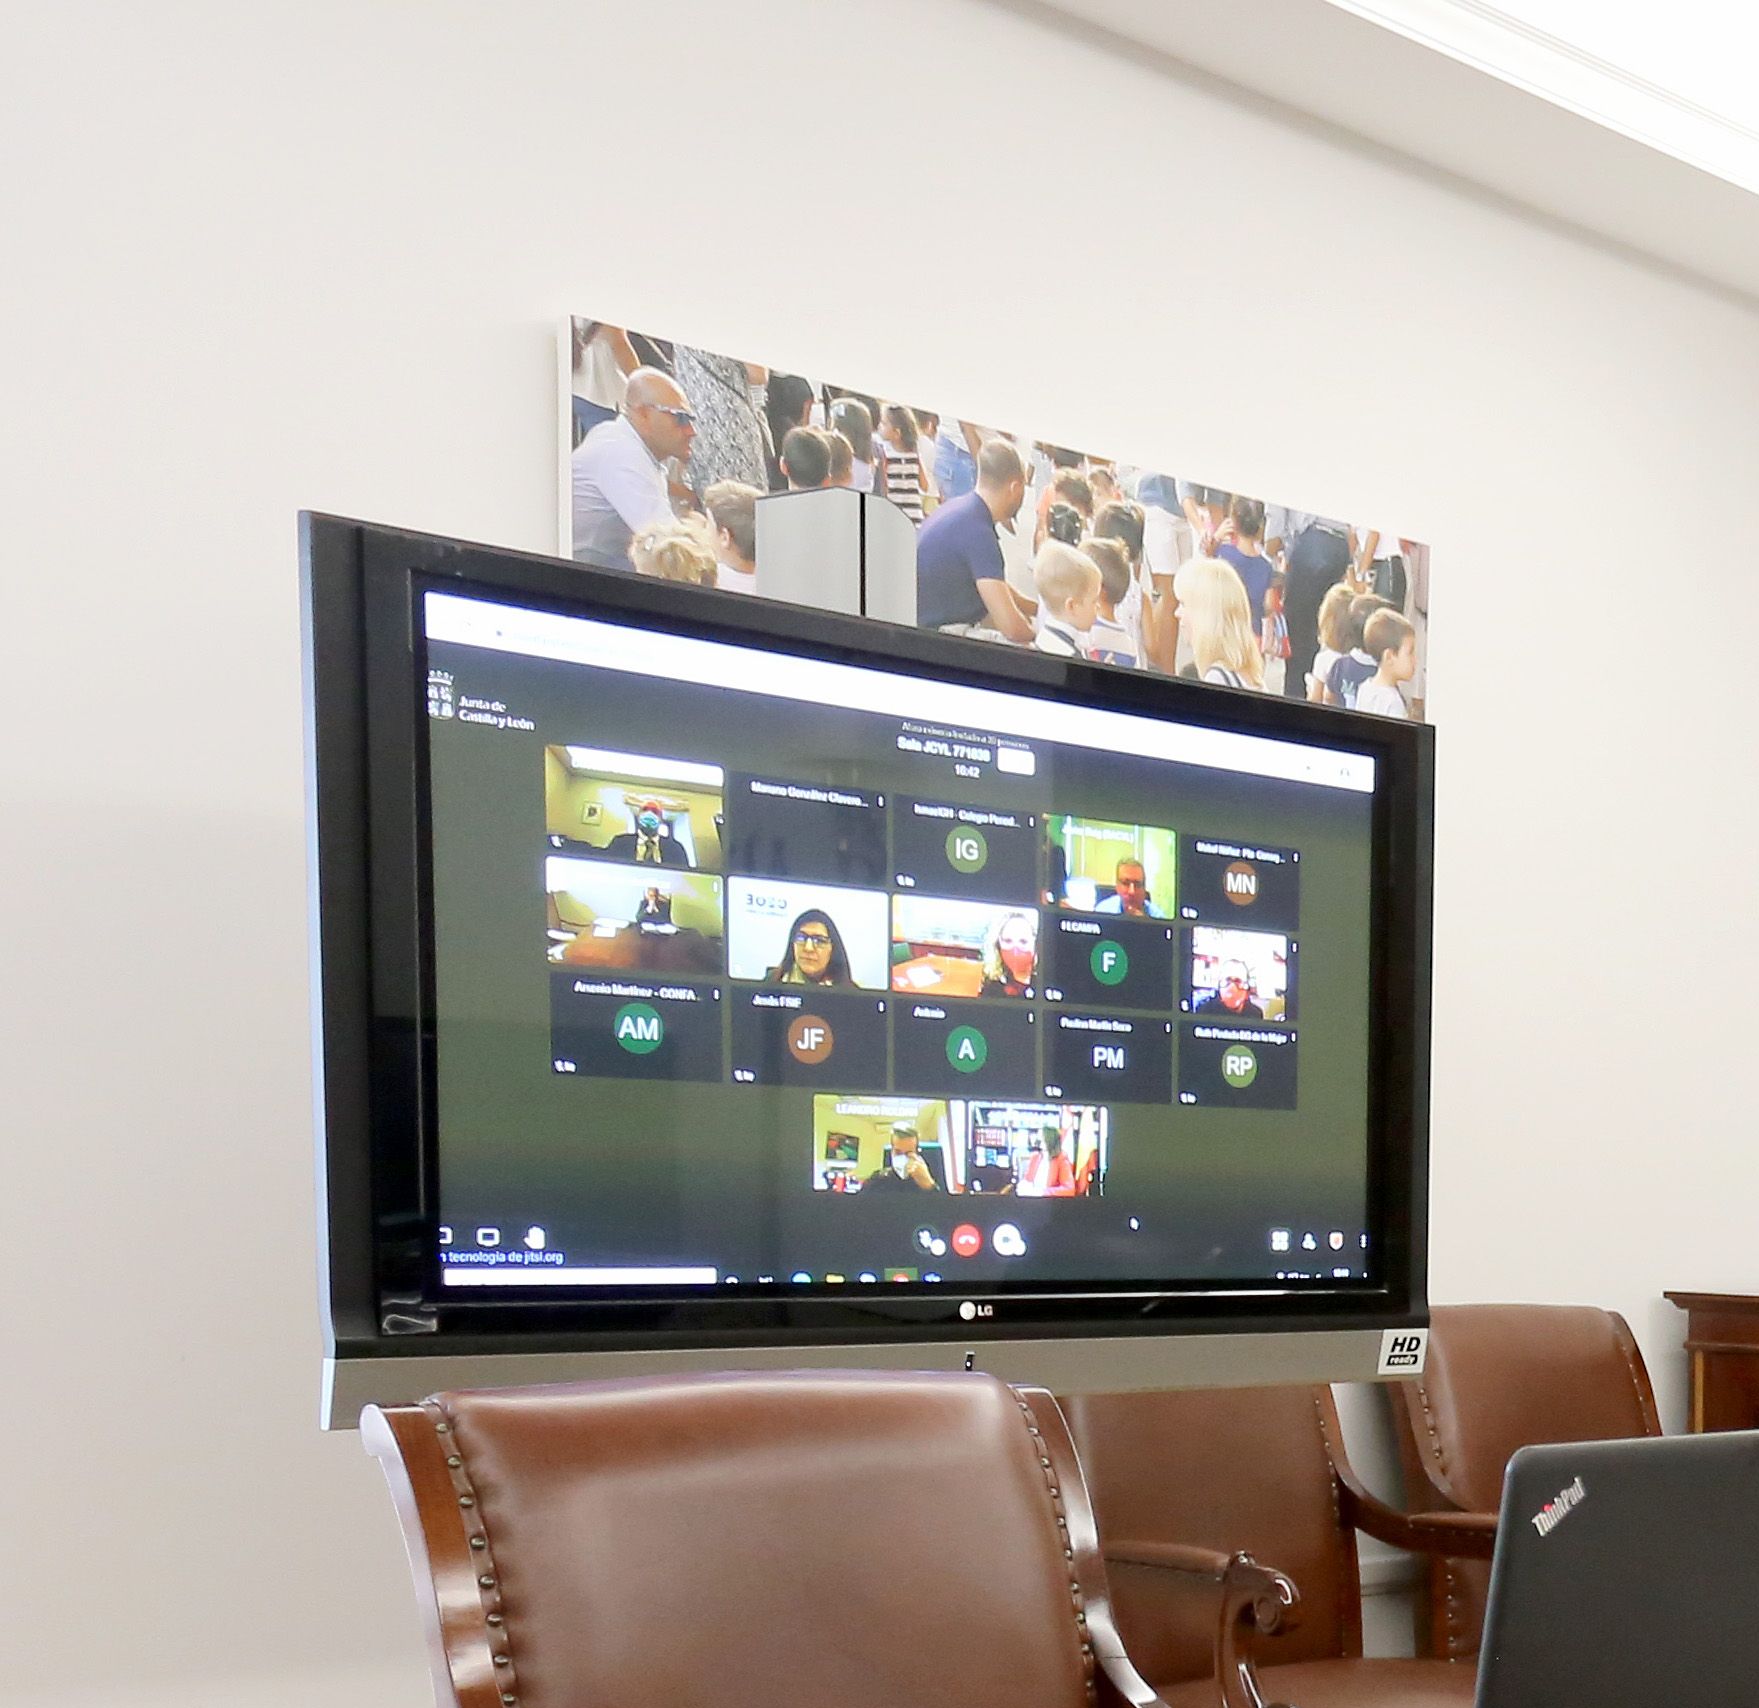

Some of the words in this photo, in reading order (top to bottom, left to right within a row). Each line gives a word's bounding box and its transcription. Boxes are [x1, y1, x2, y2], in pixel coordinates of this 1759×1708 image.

[459, 695, 490, 710] Junta
[491, 701, 507, 712] de
[459, 709, 497, 725] Castilla
[497, 717, 506, 729] y
[507, 716, 535, 731] León
[923, 740, 951, 756] JCYL
[955, 837, 979, 861] IG
[1226, 872, 1256, 895] MN
[1103, 951, 1116, 973] F
[618, 1016, 659, 1041] AM
[797, 1027, 825, 1050] JF
[958, 1037, 976, 1060] A
[1093, 1045, 1124, 1069] PM
[1226, 1055, 1253, 1076] RP
[507, 1251, 523, 1263] de
[976, 1304, 994, 1317] LG
[1391, 1336, 1421, 1353] HD
[1389, 1355, 1416, 1367] ready
[1531, 1476, 1586, 1537] ThinkPad
